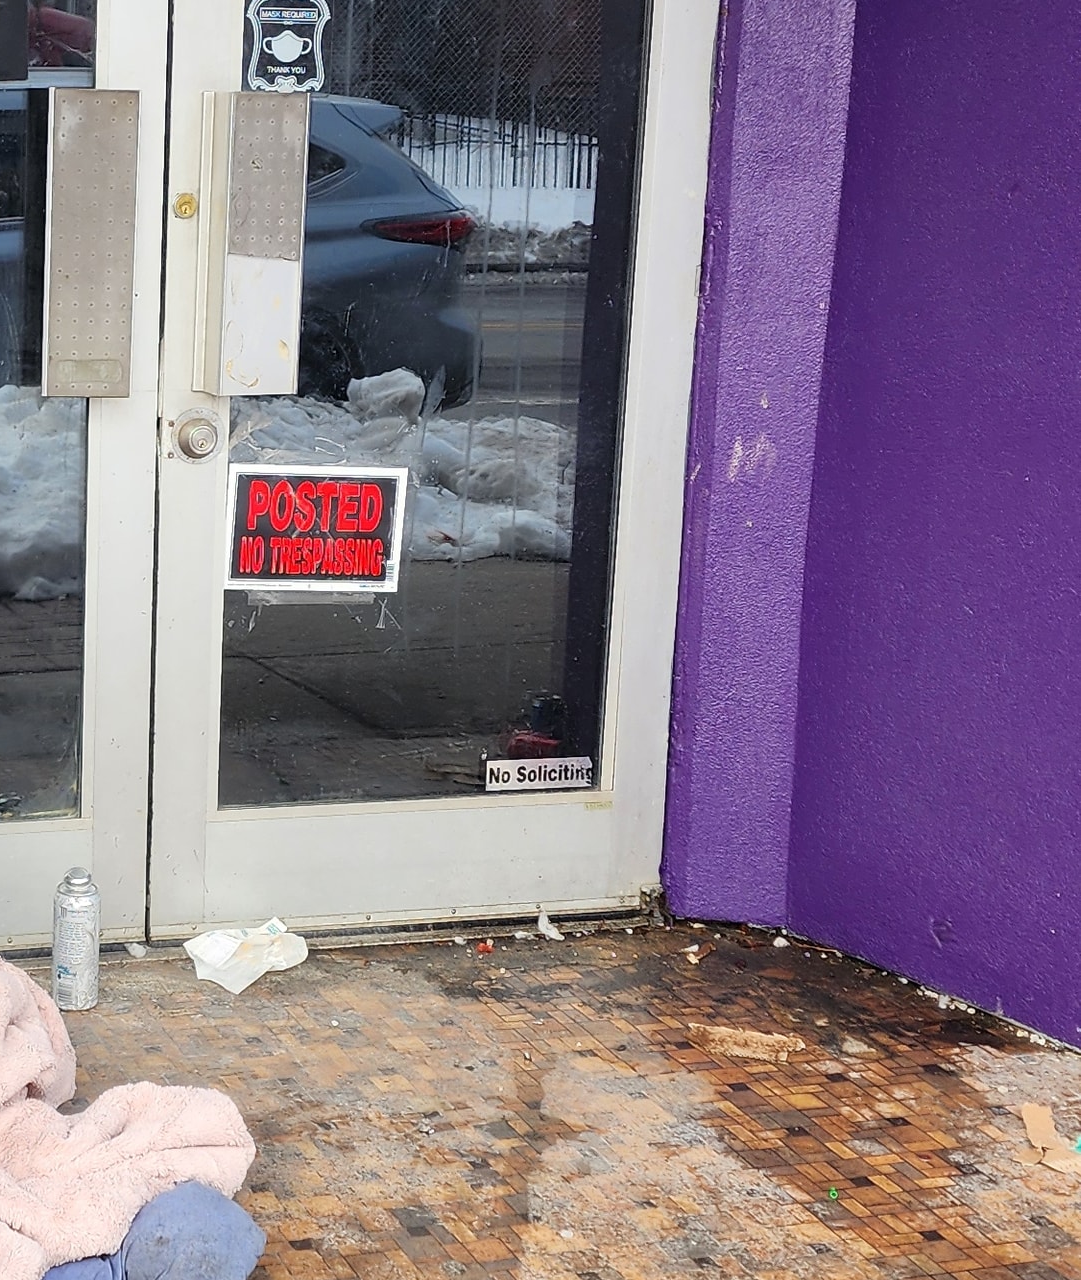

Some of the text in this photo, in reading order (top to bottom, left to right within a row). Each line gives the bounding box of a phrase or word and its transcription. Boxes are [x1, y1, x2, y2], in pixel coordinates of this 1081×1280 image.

[261, 10, 317, 19] MASK REQUIRED
[266, 65, 307, 75] THANK YOU
[247, 479, 384, 533] POSTED
[239, 535, 385, 577] NO TRESPASSING
[488, 766, 511, 785] No
